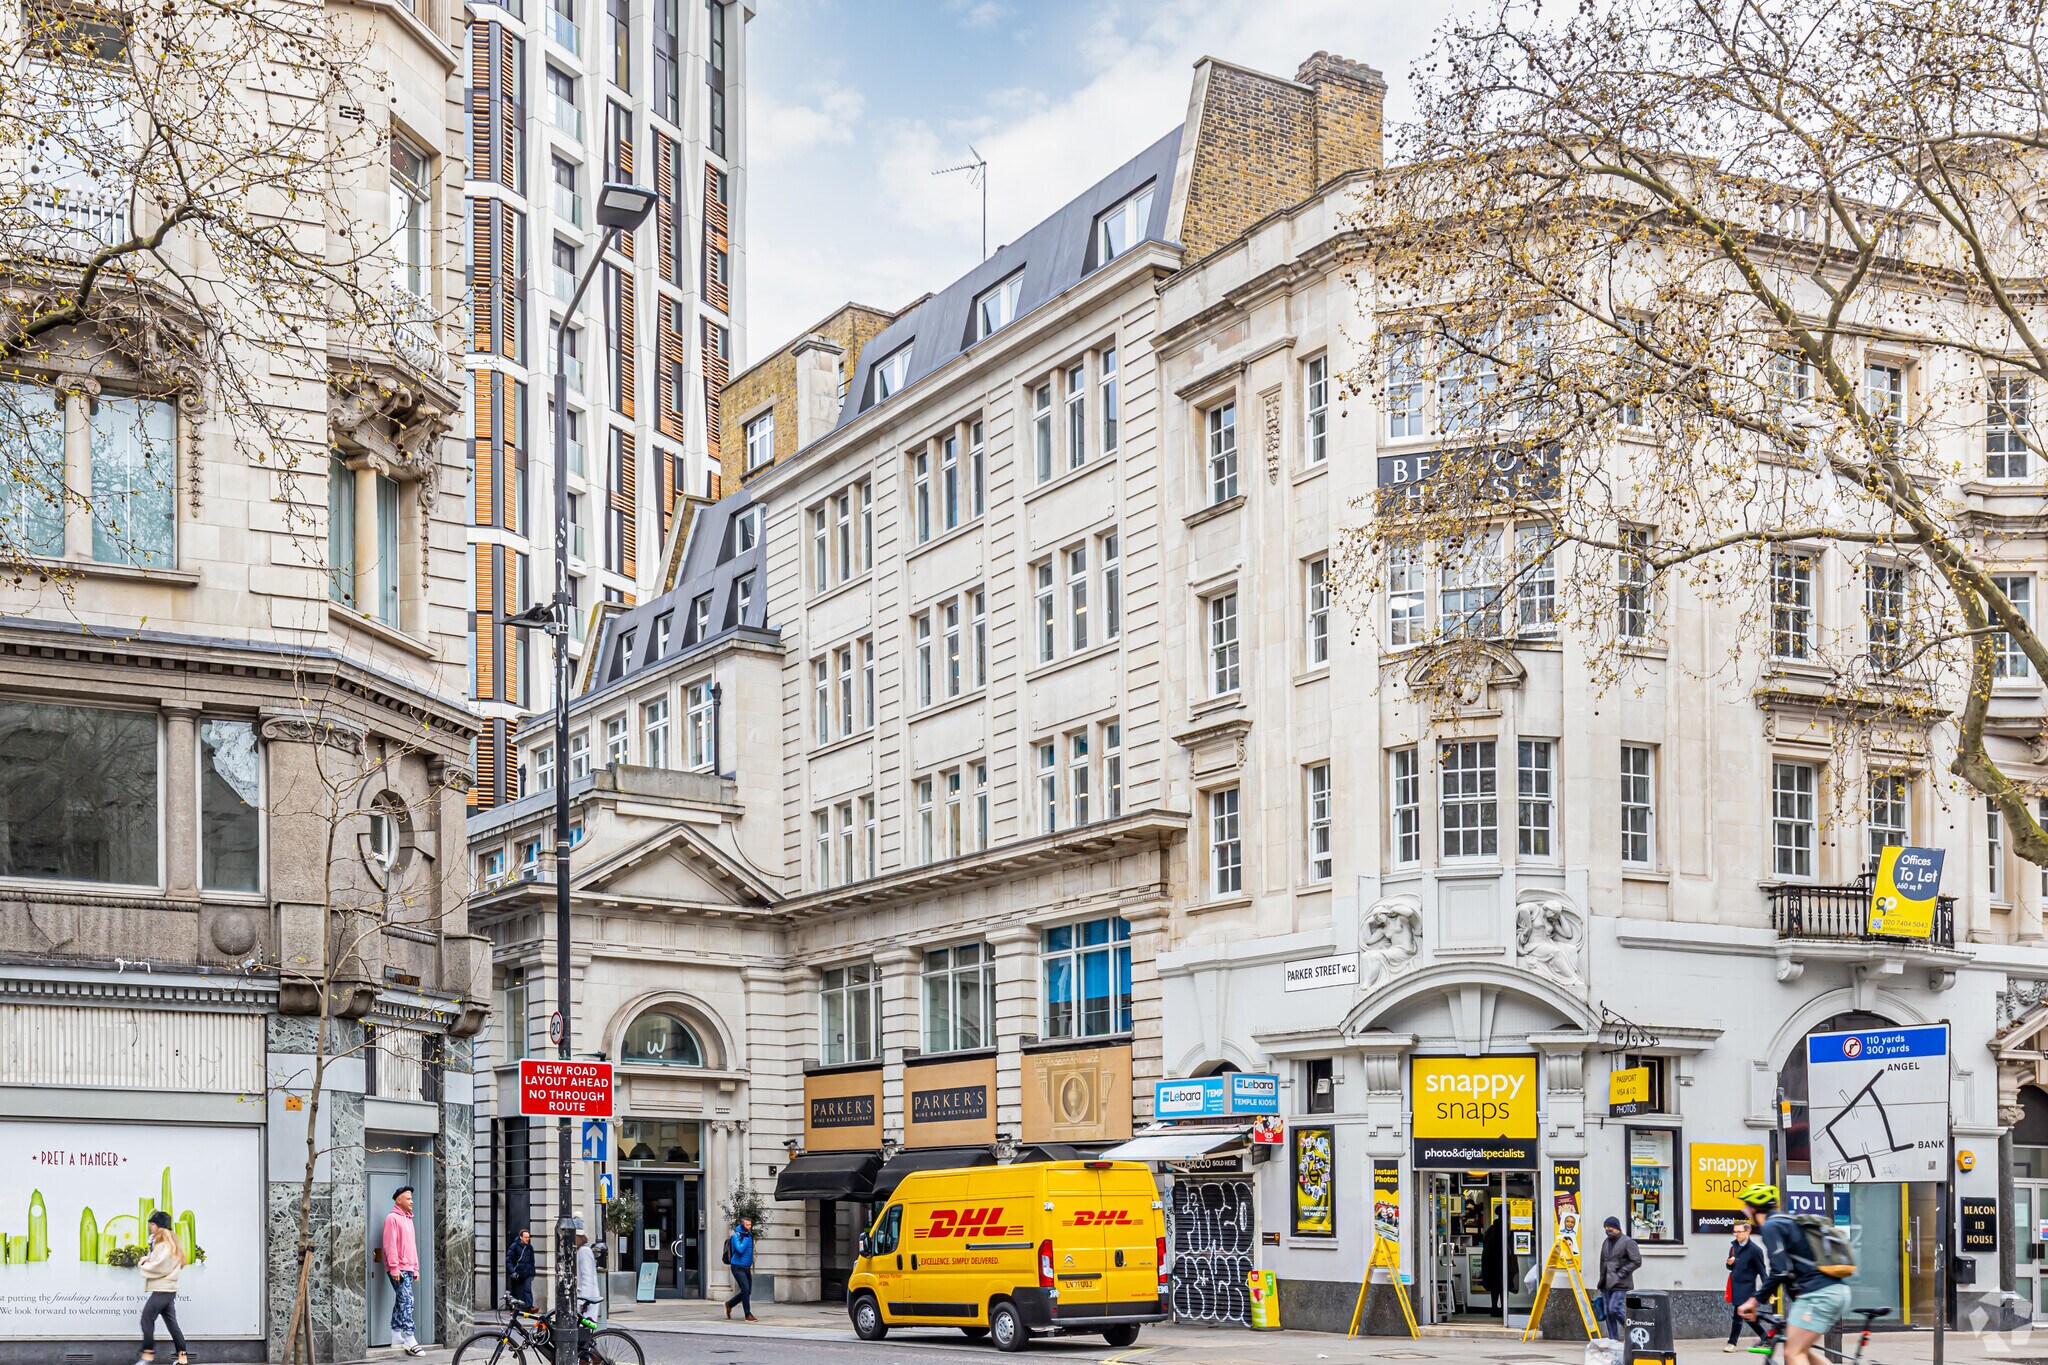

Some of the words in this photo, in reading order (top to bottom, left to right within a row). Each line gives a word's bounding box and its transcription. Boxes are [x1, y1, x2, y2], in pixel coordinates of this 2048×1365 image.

[1901, 855, 1932, 866] Offices
[1900, 867, 1914, 881] To
[1918, 868, 1938, 882] Let
[1287, 968, 1313, 981] PARKER
[1315, 964, 1341, 977] STREET
[1342, 965, 1356, 973] WC2
[552, 1022, 561, 1035] 20
[1866, 1036, 1880, 1045] 110
[1882, 1035, 1906, 1046] yards
[1866, 1046, 1884, 1054] 300
[1886, 1045, 1910, 1055] yards
[537, 1065, 562, 1075] NEW
[566, 1066, 597, 1076] ROAD
[1887, 1062, 1920, 1072] ANGEL
[525, 1075, 567, 1087] LAYOUT
[571, 1077, 609, 1088] AHEAD
[1616, 1074, 1637, 1083] PASSPORT
[1243, 1080, 1273, 1089] Lebara
[1425, 1074, 1525, 1100] snappy
[529, 1089, 547, 1099] NO
[549, 1090, 605, 1102] THROUGH
[915, 1091, 984, 1110] PARKER'S
[1170, 1091, 1201, 1101] Lebara
[549, 1102, 585, 1112] ROUTE
[1234, 1098, 1257, 1106] TEMPLE
[813, 1100, 872, 1116] PARKER'S
[947, 1107, 983, 1115] RESTAURANT
[1616, 1104, 1637, 1113] PHOTOS
[1437, 1102, 1510, 1127] snaps
[1918, 1140, 1945, 1149] BANK
[41, 1151, 65, 1165] PRET
[69, 1152, 76, 1165] A
[80, 1152, 119, 1166] MANGER
[1554, 1166, 1579, 1175] Photo
[1698, 1157, 1758, 1178] snappy
[1559, 1177, 1575, 1185] I.D.
[1790, 1195, 1811, 1210] TO
[1963, 1206, 1996, 1215] BEACON
[928, 1207, 1008, 1238] DHL
[1073, 1210, 1133, 1226] DHL
[1974, 1221, 1985, 1230] 113
[1966, 1235, 1994, 1244] HOUSE
[921, 1258, 951, 1266] EXCELLENCE.
[952, 1257, 970, 1265] SIMPLY
[970, 1256, 1000, 1265] DELIVERED.
[7, 1294, 37, 1304] putting
[39, 1293, 52, 1302] the
[48, 1291, 91, 1304] finishing
[92, 1292, 125, 1302] touches
[0, 1306, 12, 1314] We
[14, 1306, 32, 1315] look
[35, 1306, 67, 1315] forward
[79, 1306, 121, 1316] welcoming
